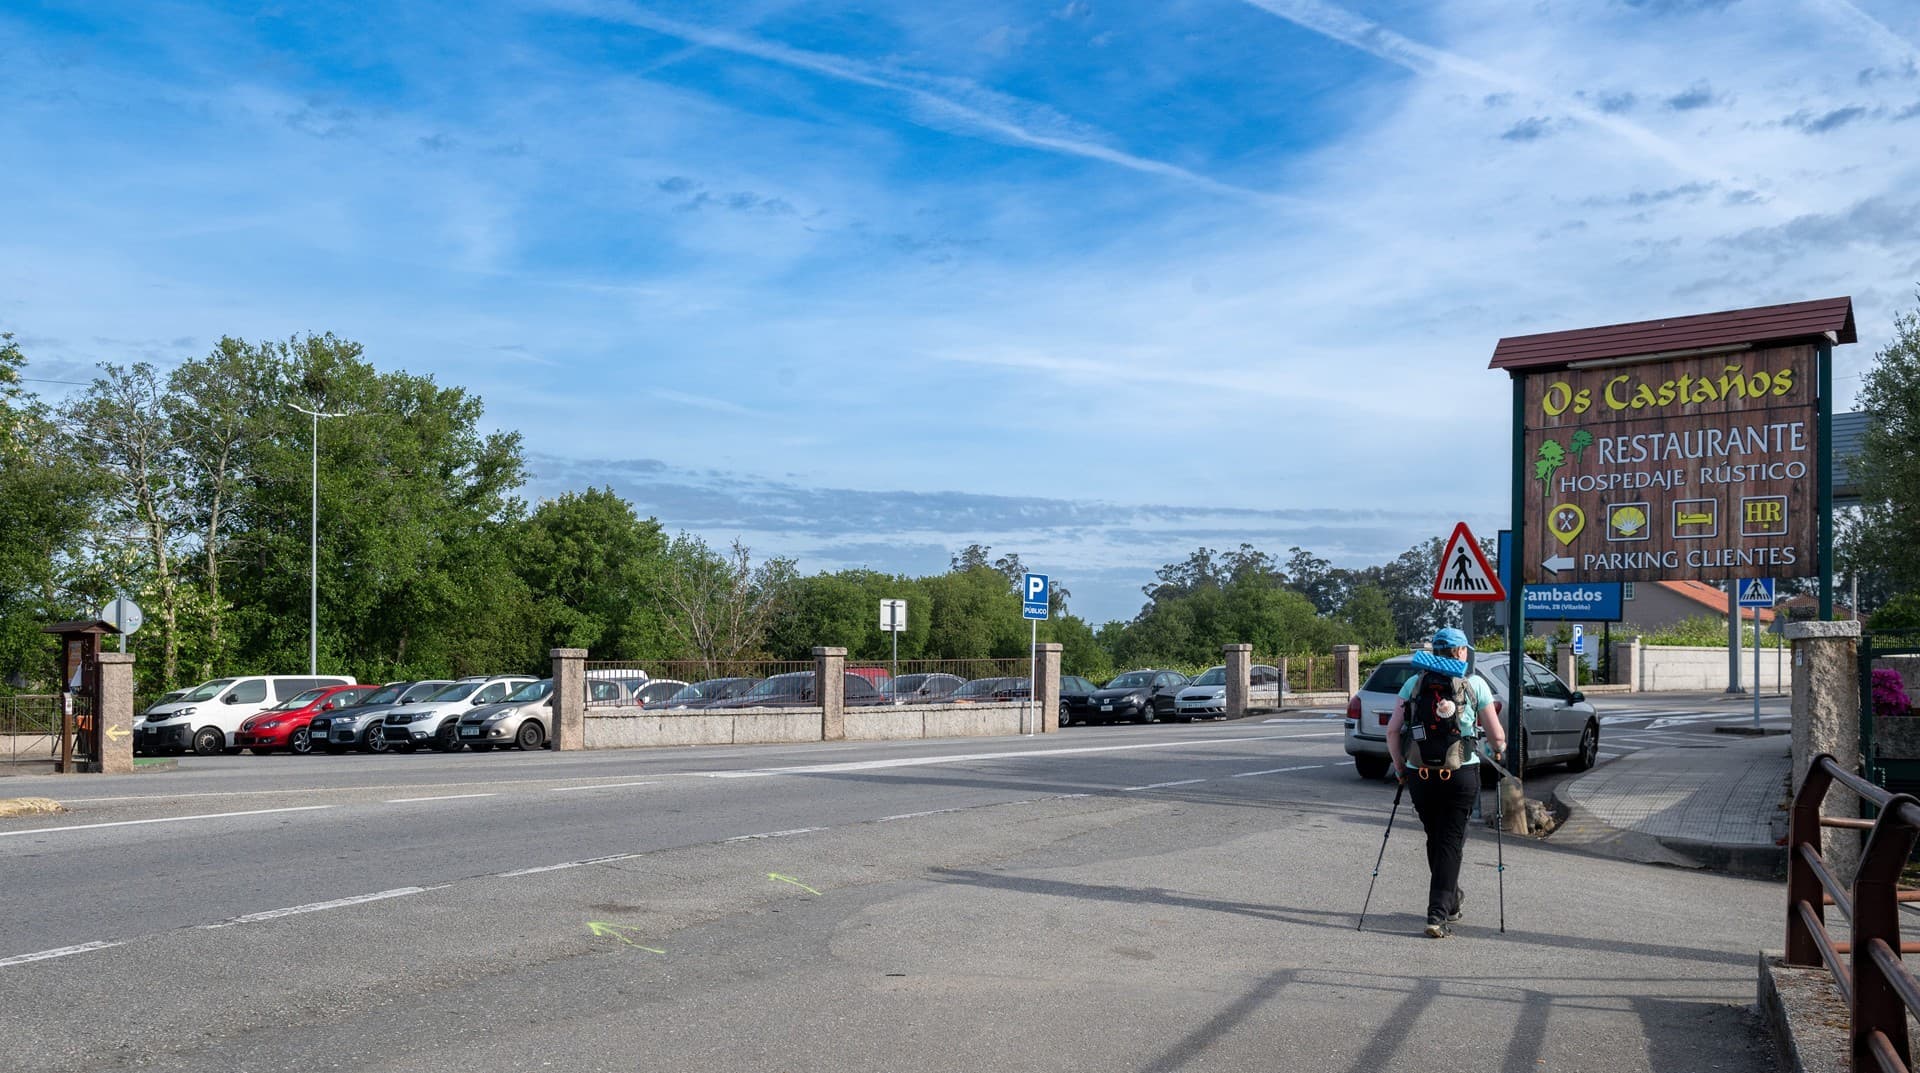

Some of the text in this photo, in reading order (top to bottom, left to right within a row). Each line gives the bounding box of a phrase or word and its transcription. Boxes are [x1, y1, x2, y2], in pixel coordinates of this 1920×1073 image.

[1542, 364, 1793, 416] Os Castaños
[1598, 422, 1806, 465] RESTAURANTE
[1560, 461, 1807, 493] HOSPEDAJE RÚSTICO
[1745, 502, 1783, 523] HR
[1583, 546, 1796, 571] PARKING CLIENTES
[1029, 577, 1044, 600] P
[1024, 606, 1047, 615] PÚBLICO
[1575, 627, 1581, 641] P
